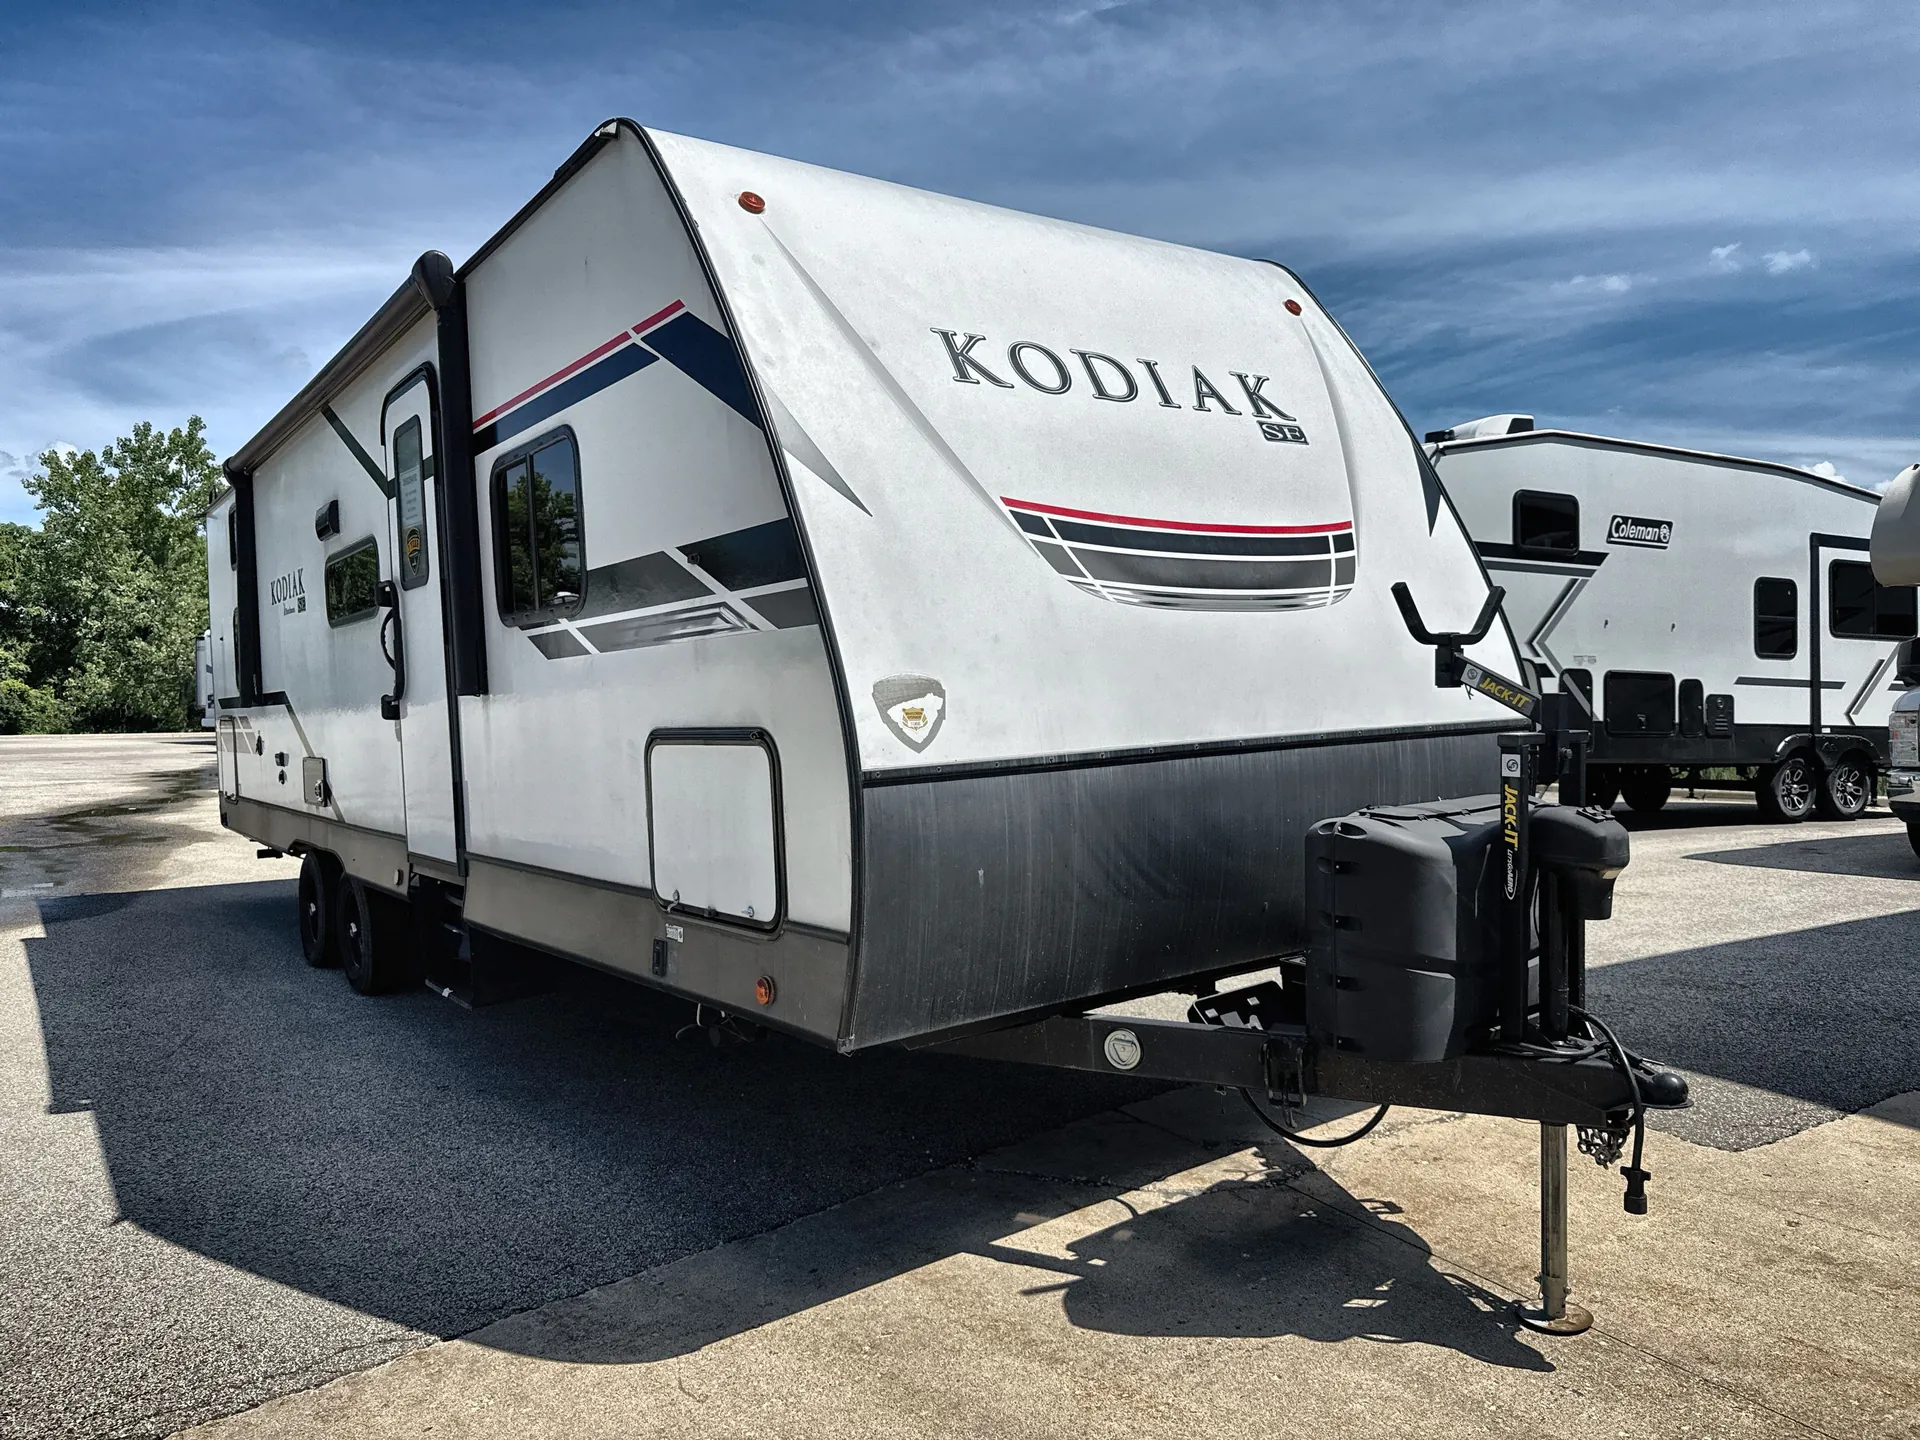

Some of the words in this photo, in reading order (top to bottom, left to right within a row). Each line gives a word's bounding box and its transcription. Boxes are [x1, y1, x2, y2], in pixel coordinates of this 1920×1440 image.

[931, 327, 1297, 422] KODIAK
[1264, 423, 1307, 443] SE
[1612, 517, 1660, 541] Coleman
[271, 568, 305, 605] KODIAK
[1480, 678, 1531, 708] JACK-IT
[1505, 784, 1519, 850] JACK-IT
